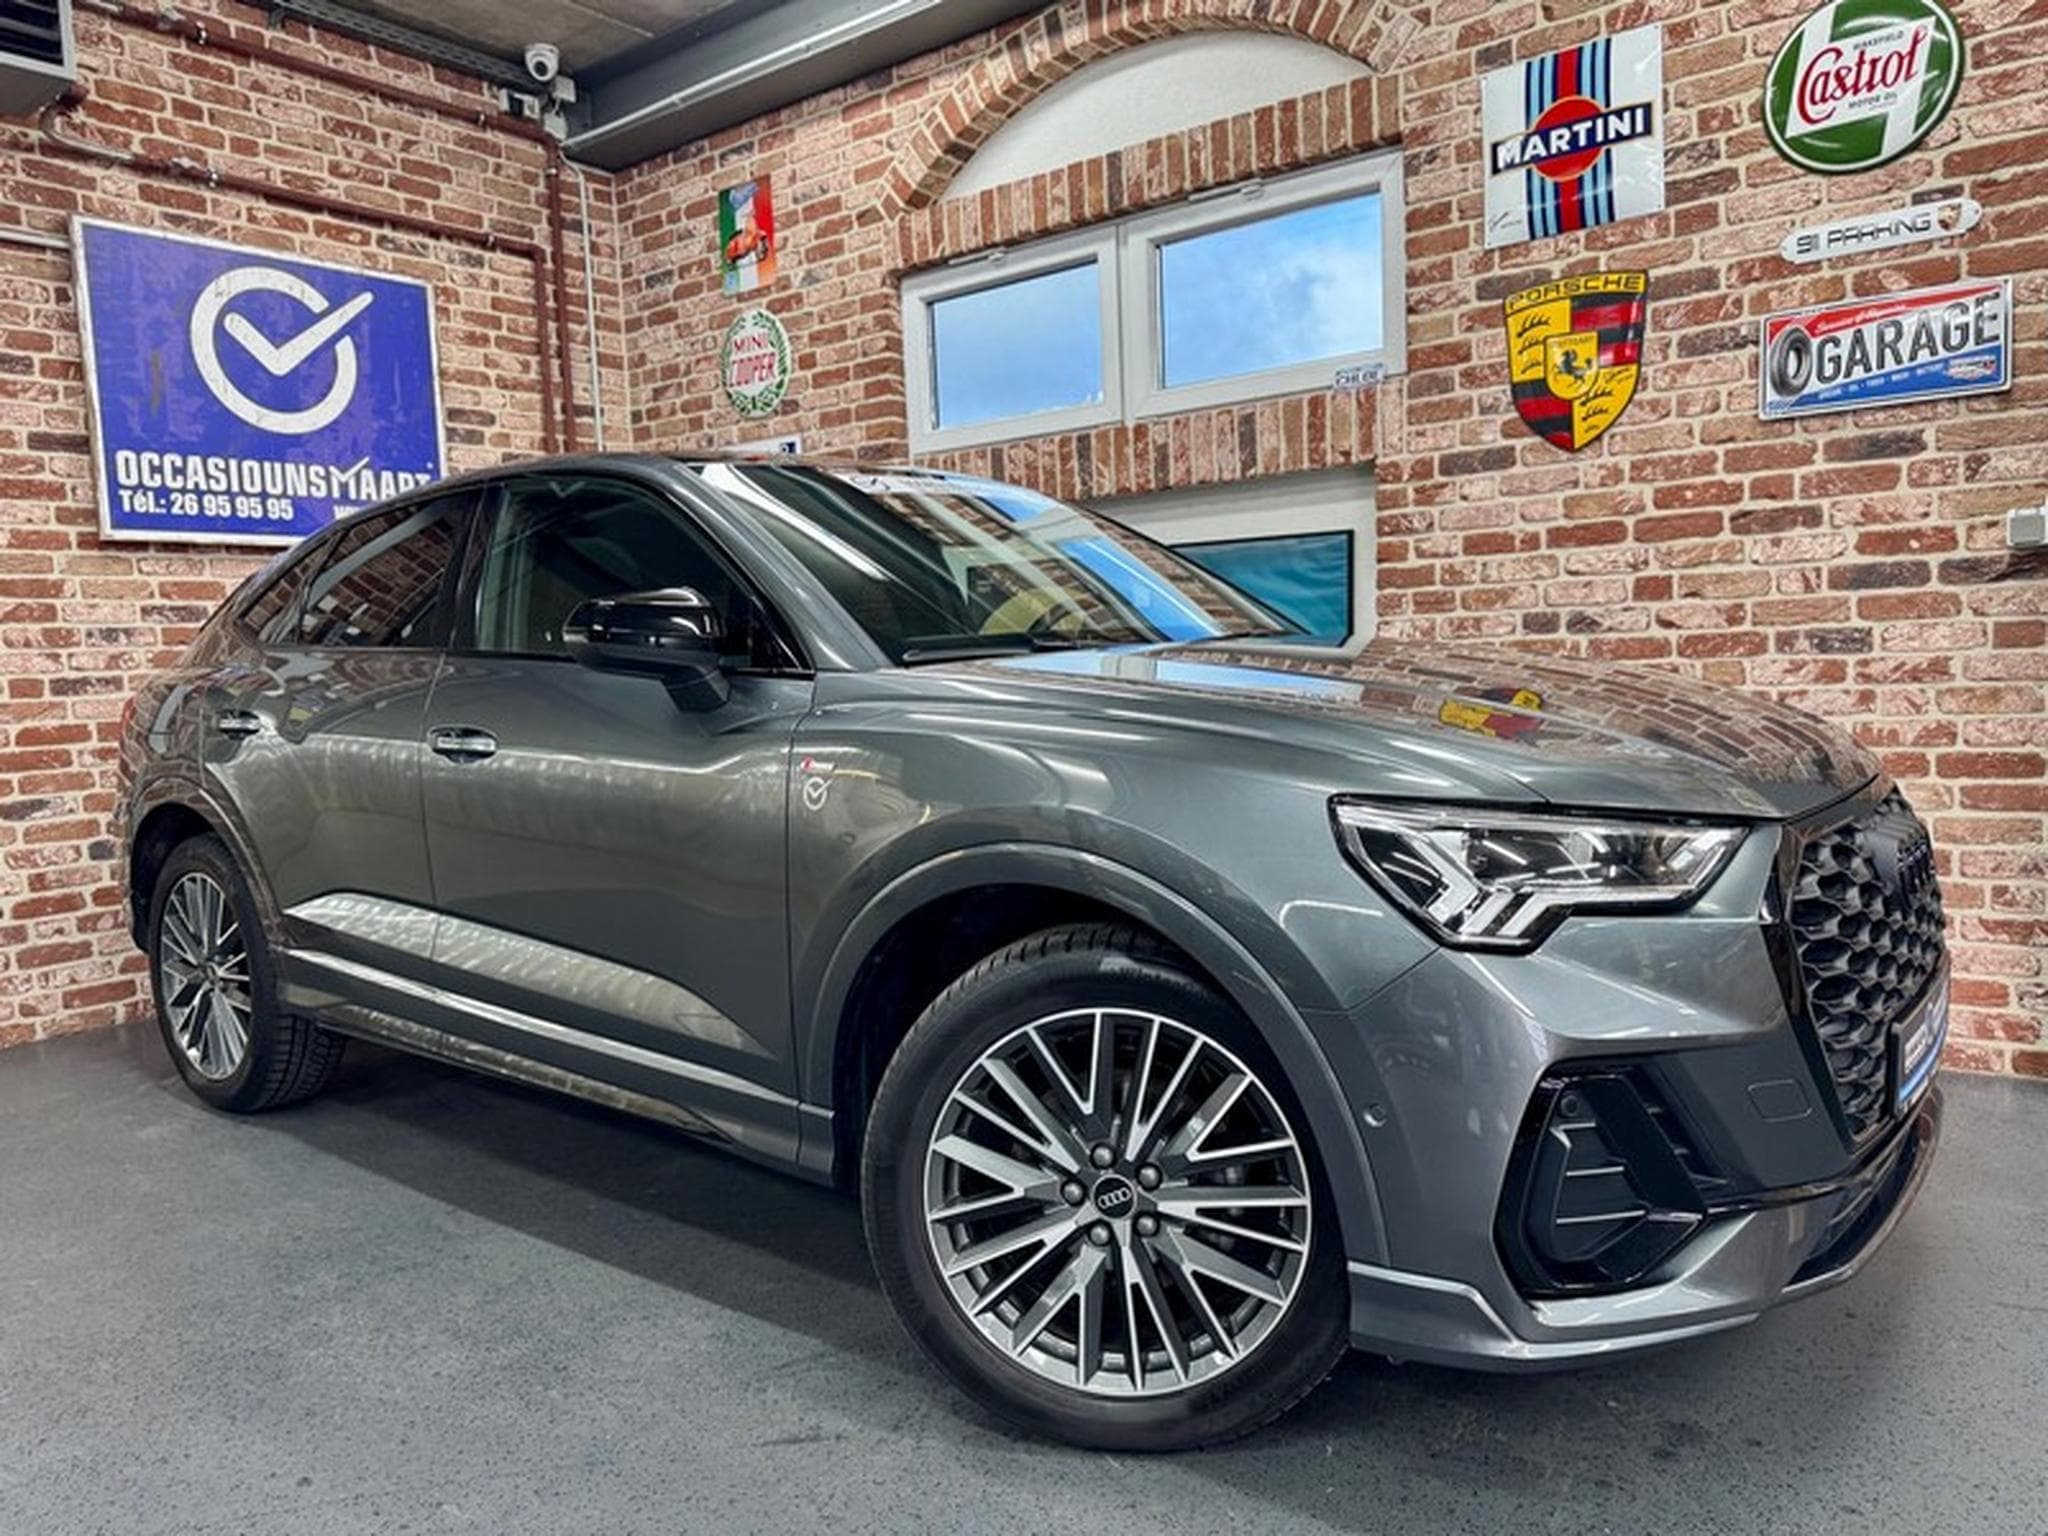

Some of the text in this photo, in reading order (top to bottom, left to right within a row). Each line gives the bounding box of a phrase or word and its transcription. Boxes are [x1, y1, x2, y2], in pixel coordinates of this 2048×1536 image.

[1798, 26, 1927, 124] Castrol
[1496, 107, 1645, 170] MARTINI
[1827, 211, 1932, 249] PARKING
[1508, 275, 1642, 311] PORSCHE
[733, 332, 769, 353] MINI
[1815, 291, 2001, 385] GARAGE
[169, 491, 200, 517] 26
[202, 494, 233, 518] 95
[235, 496, 264, 519] 95
[265, 498, 295, 521] 95
